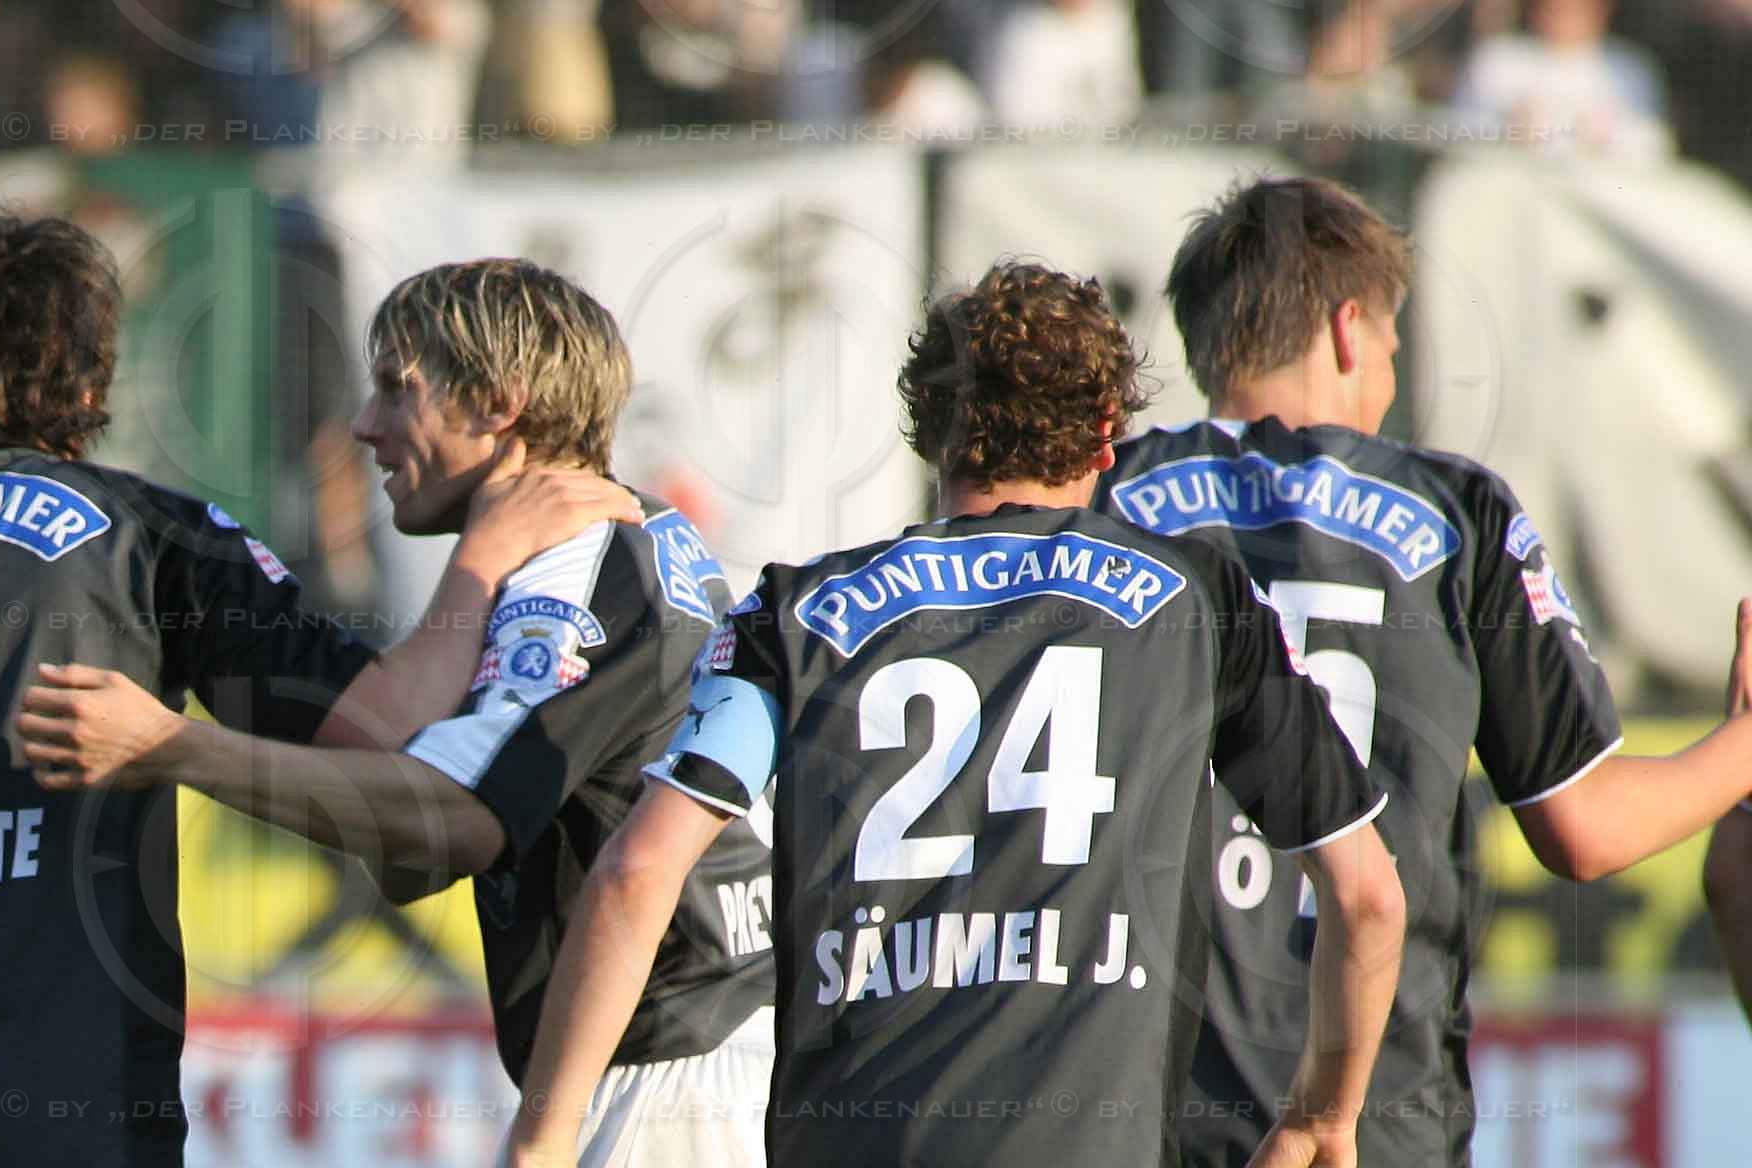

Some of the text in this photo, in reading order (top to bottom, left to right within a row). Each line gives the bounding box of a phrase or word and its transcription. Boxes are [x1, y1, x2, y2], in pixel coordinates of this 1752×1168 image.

[1128, 470, 1441, 569] PUNTIGAMER
[809, 546, 1162, 635] PUNTIGAMER
[854, 646, 1116, 883] 24
[815, 906, 1148, 1006] SÄUMEL J.
